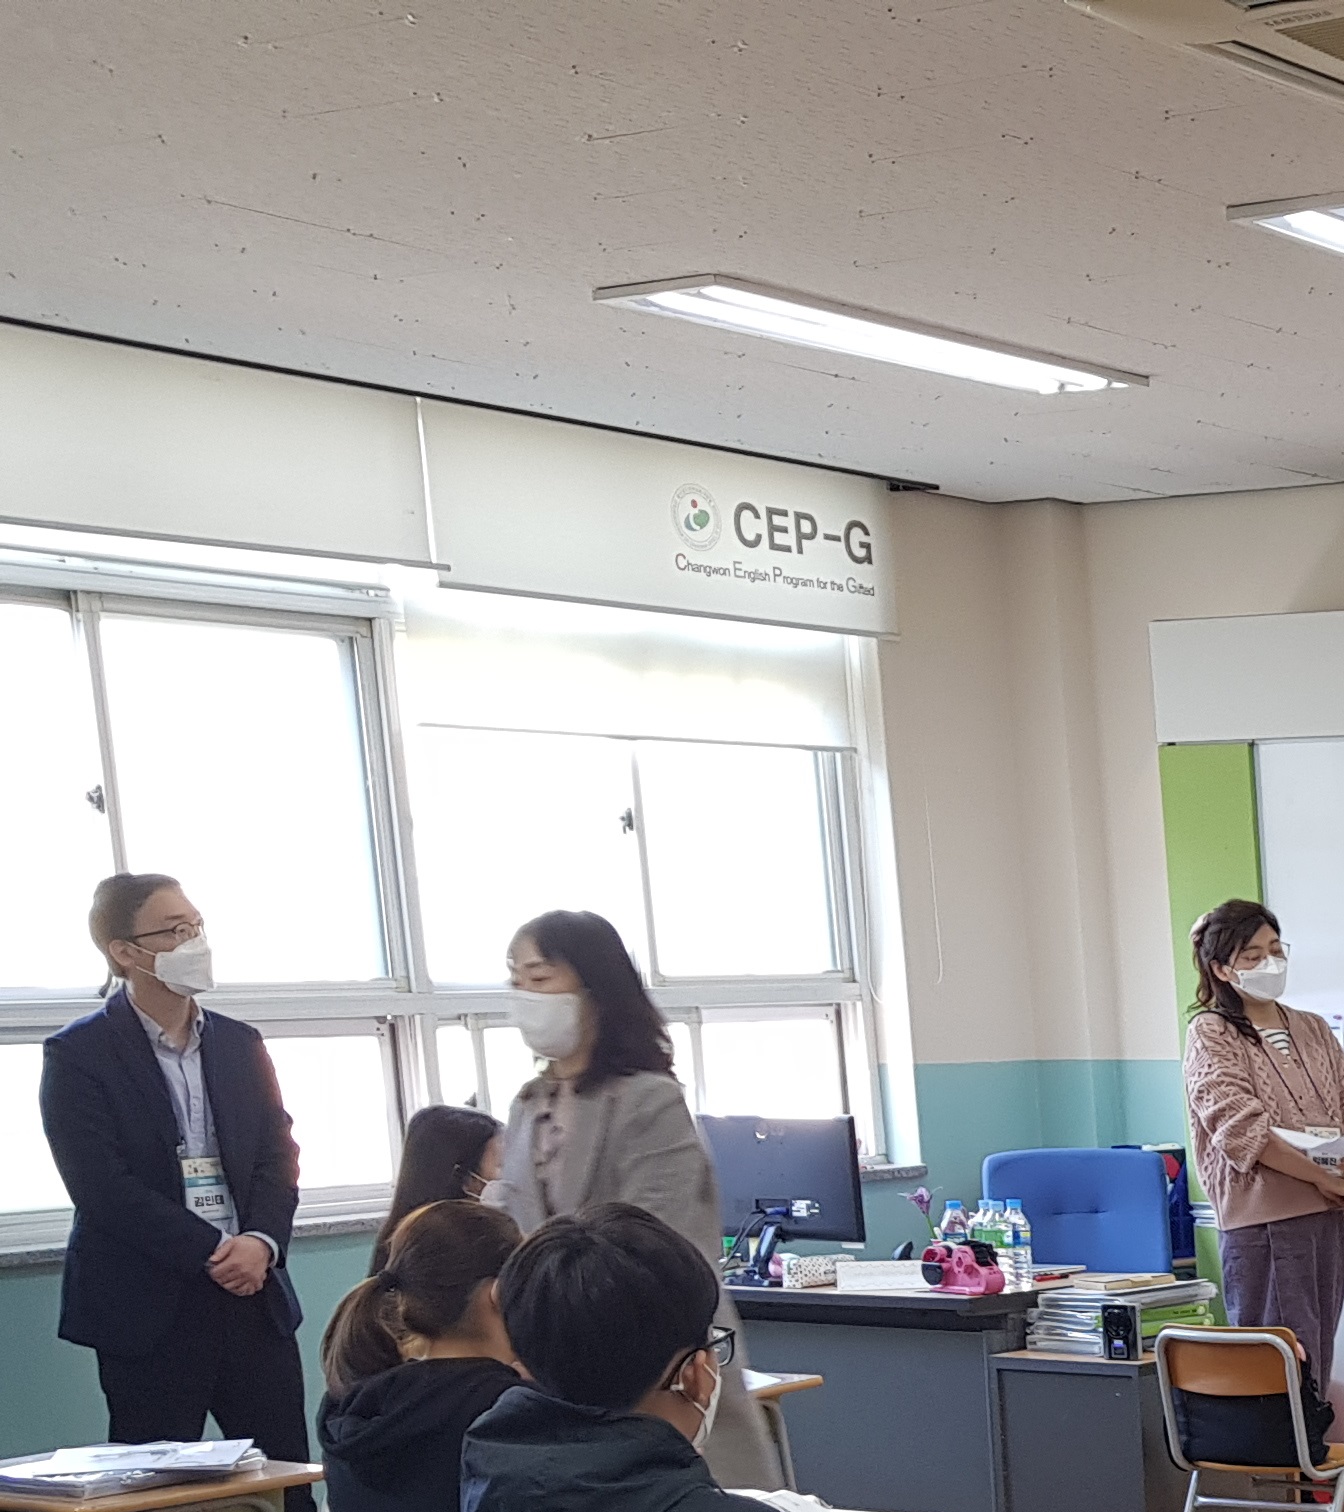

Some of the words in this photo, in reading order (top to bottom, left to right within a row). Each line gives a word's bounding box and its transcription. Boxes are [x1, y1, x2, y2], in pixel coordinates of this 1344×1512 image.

[733, 501, 874, 566] CEP-G
[674, 552, 731, 577] Changwon
[732, 560, 771, 583] English
[772, 566, 815, 588] Program
[816, 577, 828, 590] for
[830, 580, 844, 593] the
